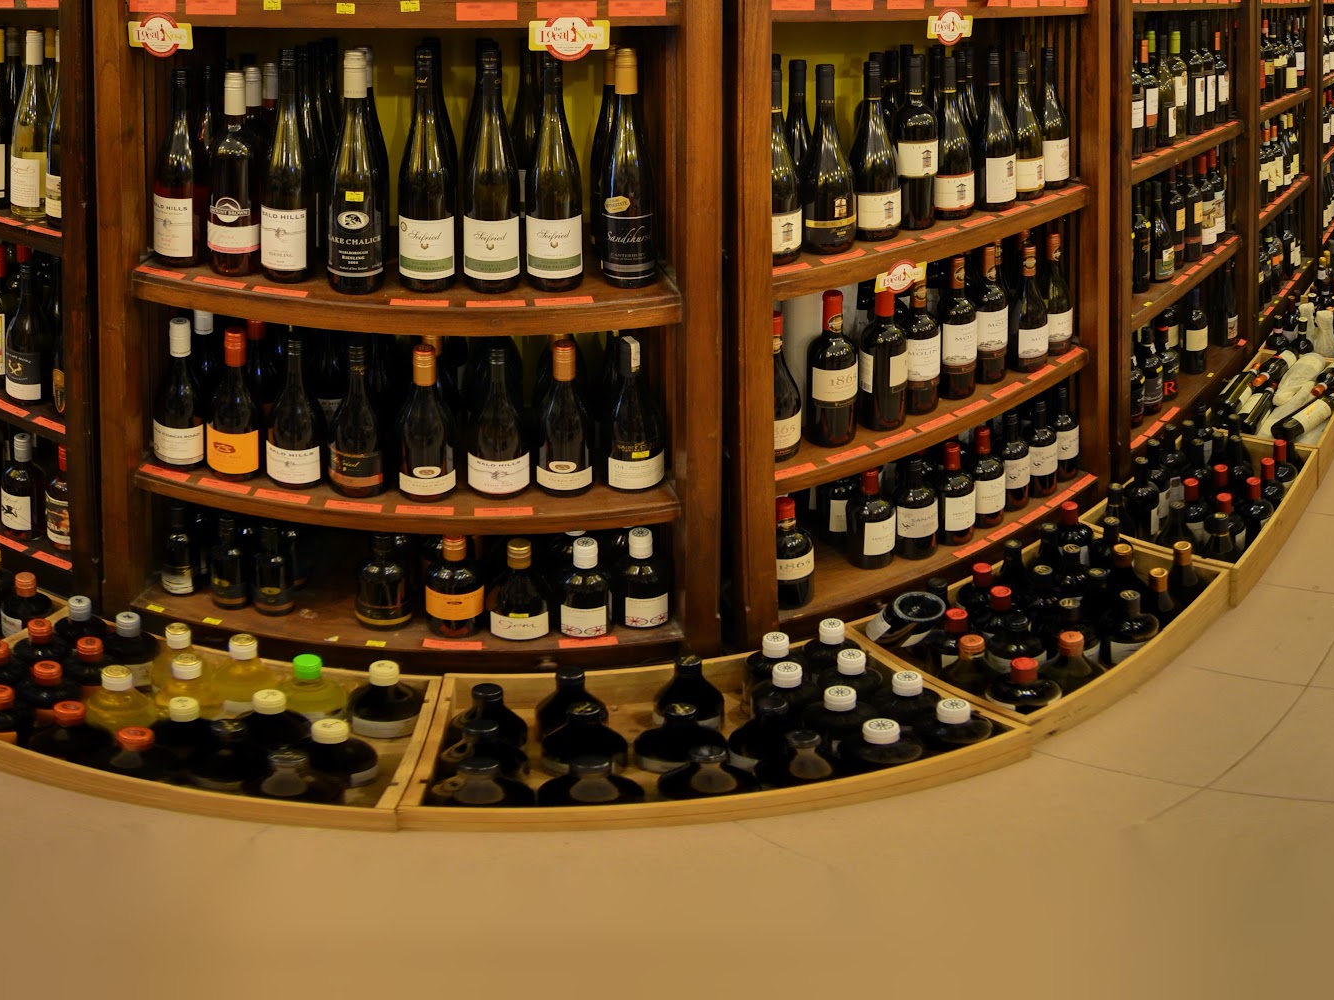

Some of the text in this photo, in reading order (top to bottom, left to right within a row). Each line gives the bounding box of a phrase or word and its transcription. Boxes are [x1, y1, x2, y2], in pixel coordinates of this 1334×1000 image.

[540, 28, 602, 43] Local Nose
[346, 235, 382, 245] CHALICE
[407, 231, 442, 242] Seifried
[473, 231, 507, 243] Seifried
[536, 228, 571, 241] Seifried
[829, 371, 858, 387] 1865
[778, 558, 812, 572] 1865
